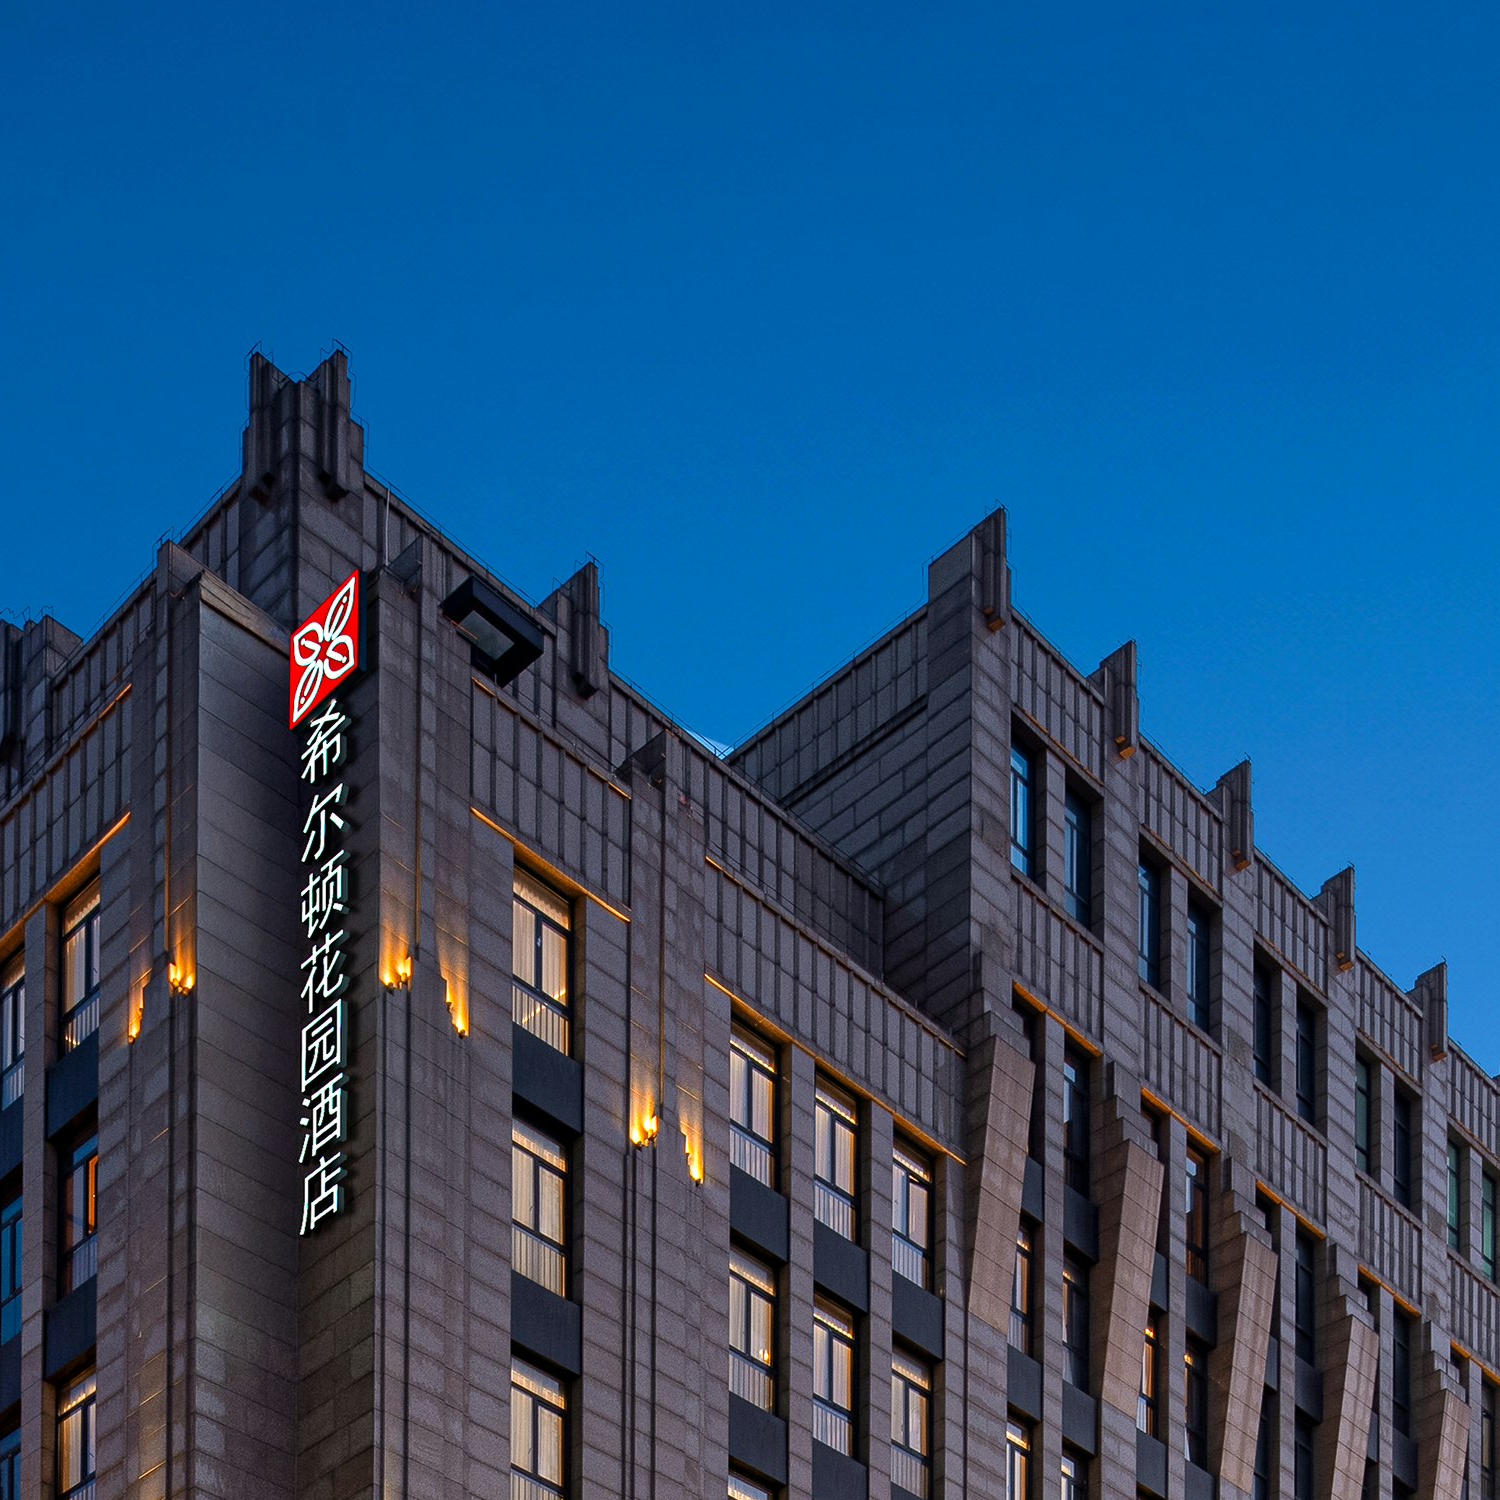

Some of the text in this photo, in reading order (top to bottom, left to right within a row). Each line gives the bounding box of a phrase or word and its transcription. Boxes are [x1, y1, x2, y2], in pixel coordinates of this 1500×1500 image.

[299, 699, 345, 1235] 希尔顿花园酒店
